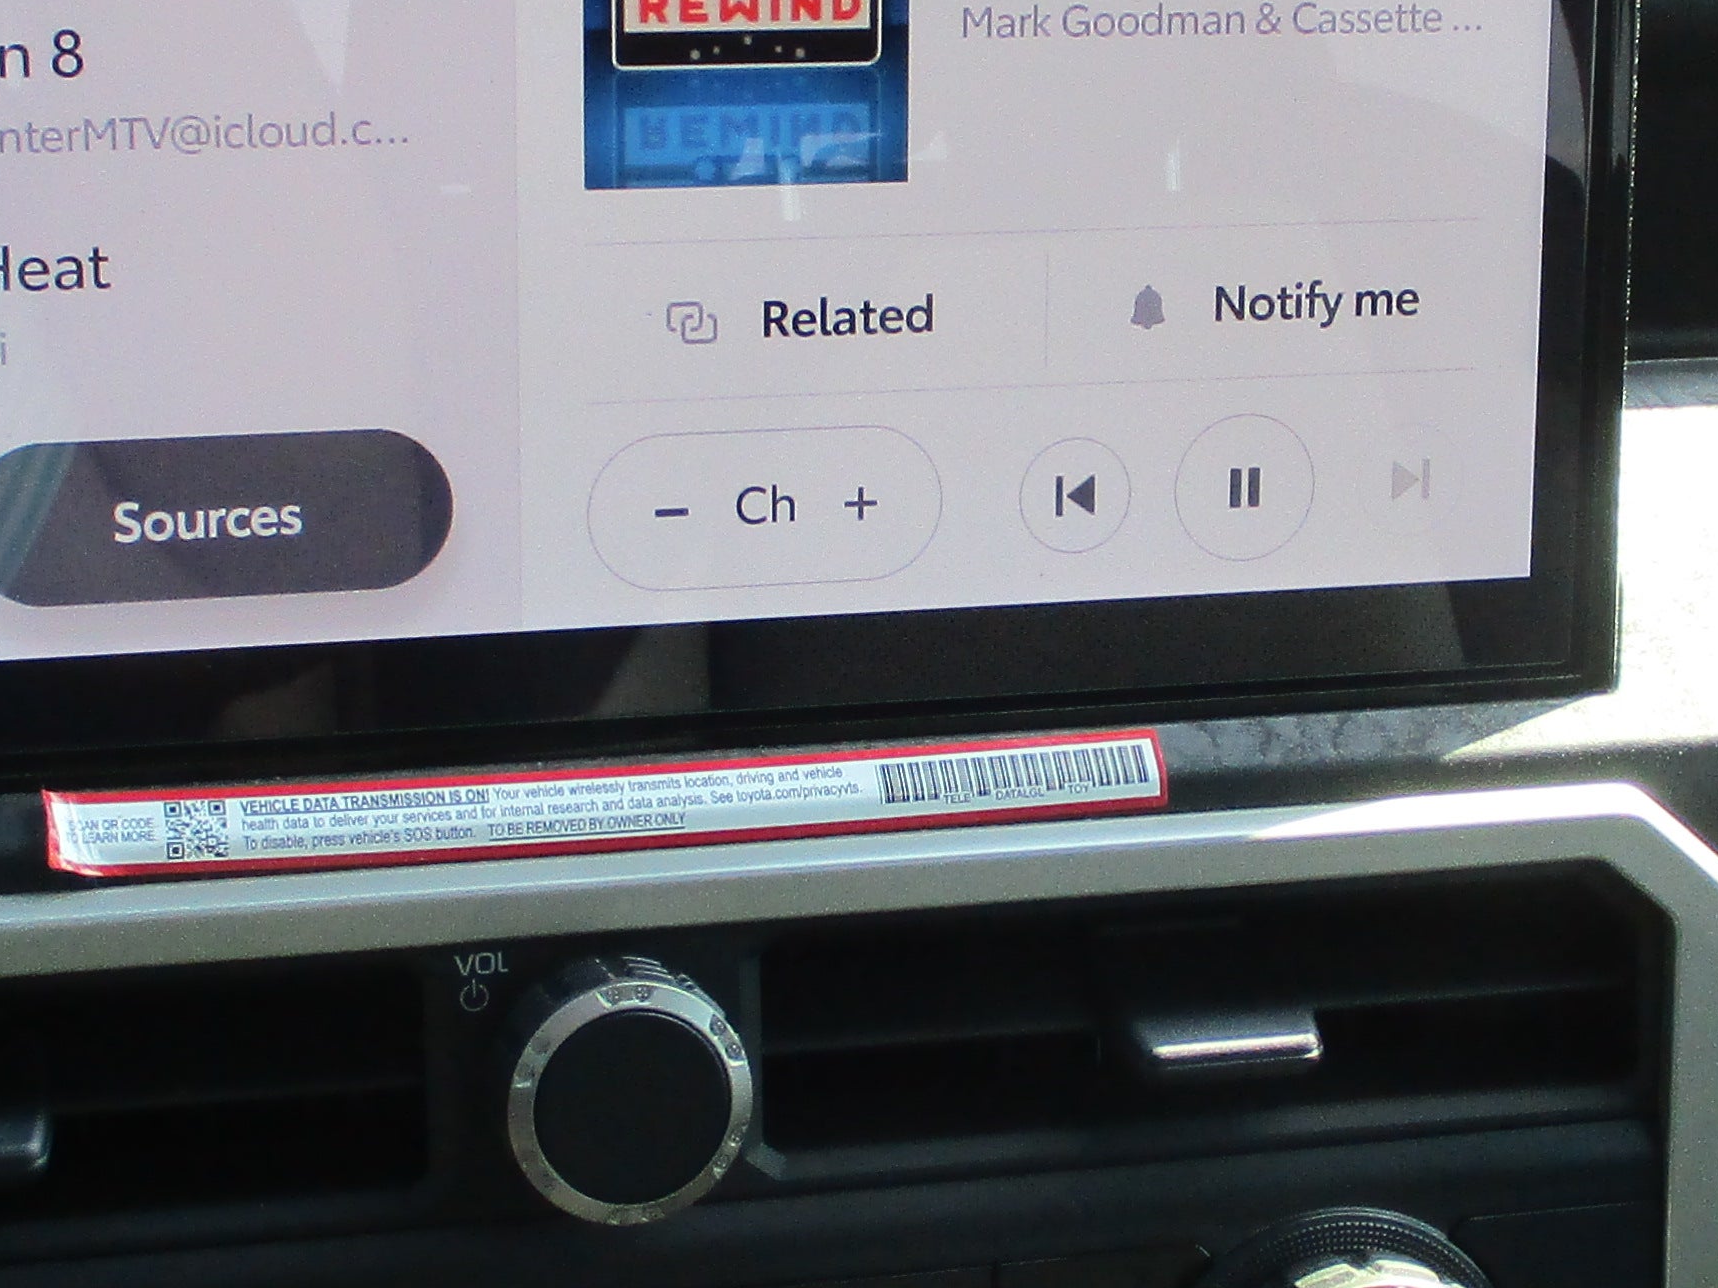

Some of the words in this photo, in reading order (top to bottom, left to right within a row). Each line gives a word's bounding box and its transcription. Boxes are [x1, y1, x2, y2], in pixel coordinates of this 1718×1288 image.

[961, 3, 1052, 39] Mark
[1061, 2, 1247, 39] Goodman
[1255, 3, 1282, 37] &
[1291, 1, 1443, 37] Cassette
[50, 30, 85, 80] 8
[761, 294, 935, 341] Related
[1213, 279, 1344, 331] Notify
[1354, 287, 1420, 318] me
[112, 499, 304, 545] Sources
[735, 485, 797, 524] Ch
[239, 798, 299, 814] VEHICLE
[302, 795, 341, 812] DATA
[343, 792, 447, 809] TRANSMISSION
[449, 791, 462, 804] IS
[493, 787, 520, 801] Your
[523, 784, 565, 799] vehicle
[568, 780, 625, 797] wirelessly
[628, 776, 682, 791] transmits
[684, 774, 734, 790] location,
[736, 771, 775, 787] driving
[778, 768, 799, 781] and
[803, 766, 843, 780] vehicle
[1066, 782, 1090, 794] TOY
[242, 816, 279, 832] health
[283, 815, 309, 829] data
[313, 815, 325, 828] to
[329, 812, 369, 828] deliver
[372, 813, 400, 830] your
[402, 809, 451, 824] services
[455, 807, 479, 822] and
[481, 804, 497, 819] for
[500, 801, 545, 816] internal
[547, 798, 599, 814] research
[602, 796, 625, 811] and
[628, 795, 653, 809] data
[656, 791, 707, 808] analysis.
[710, 790, 734, 805] See
[244, 835, 257, 850] To
[261, 832, 308, 850] disable,
[312, 832, 346, 849] press
[349, 827, 401, 845] vehicle's
[404, 826, 433, 842] SOS
[435, 823, 477, 840] button.
[489, 823, 504, 837] TO
[507, 821, 524, 836] BE
[526, 817, 586, 835] REMOVED
[588, 816, 604, 831] BY
[607, 813, 653, 830] OWNER
[655, 811, 687, 827] ONLY
[454, 951, 509, 976] VOL
